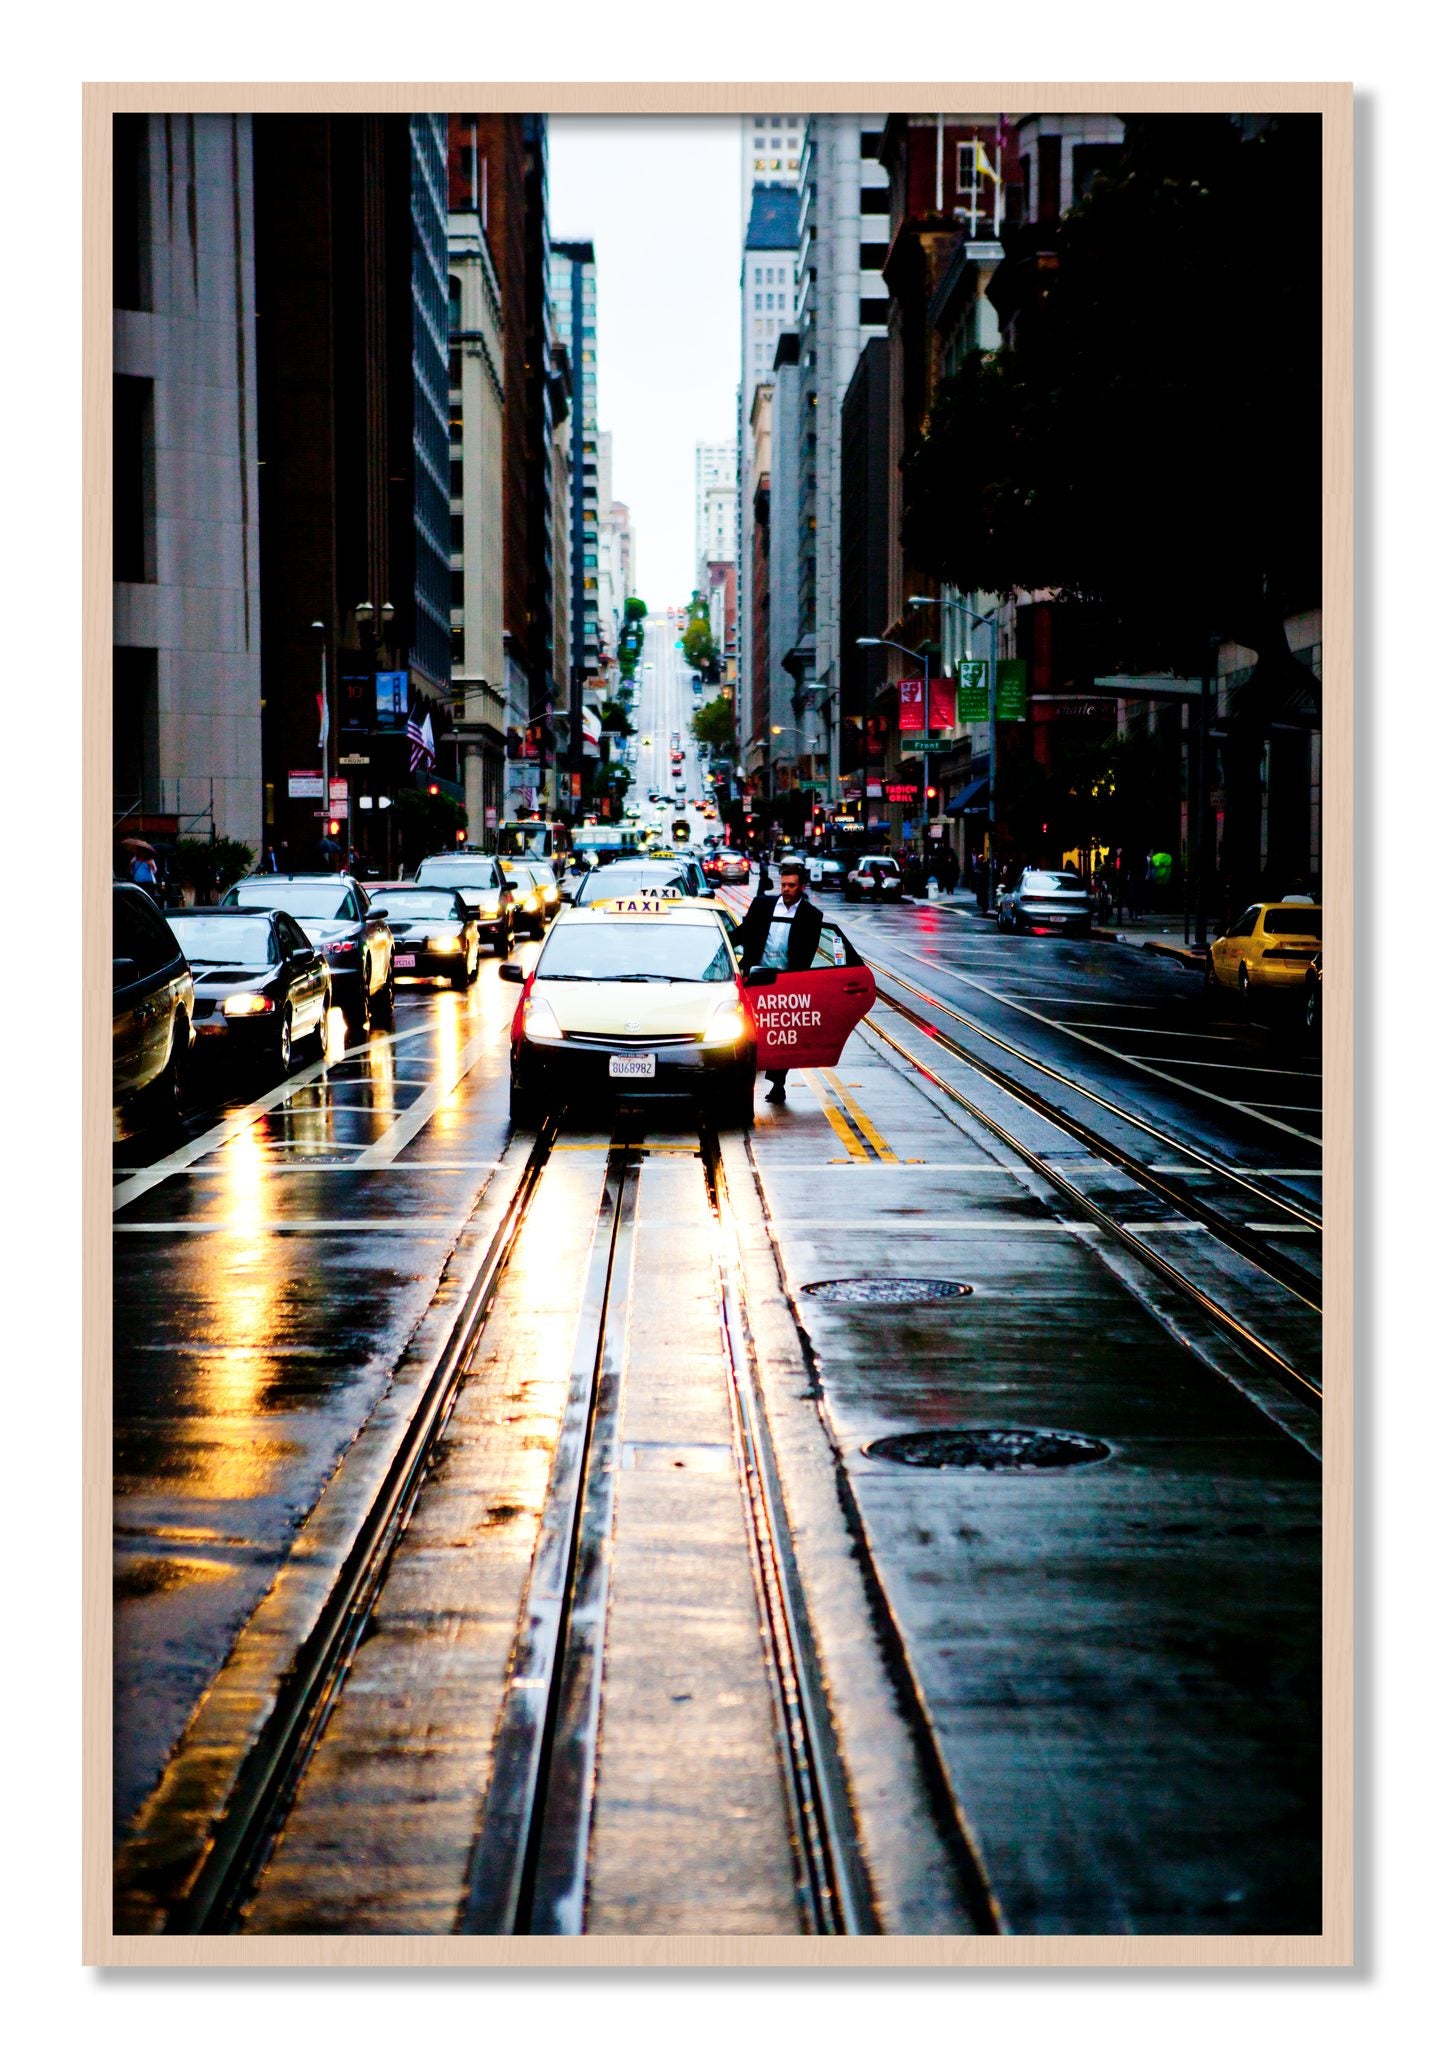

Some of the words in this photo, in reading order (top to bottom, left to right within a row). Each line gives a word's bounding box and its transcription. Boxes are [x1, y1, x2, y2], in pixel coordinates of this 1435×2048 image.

[885, 785, 918, 793] TADICH
[889, 794, 913, 802] GRILL
[641, 889, 675, 897] TAXI
[616, 901, 659, 911] TAXI
[757, 993, 811, 1009] ARROW
[767, 1030, 797, 1045] CAB
